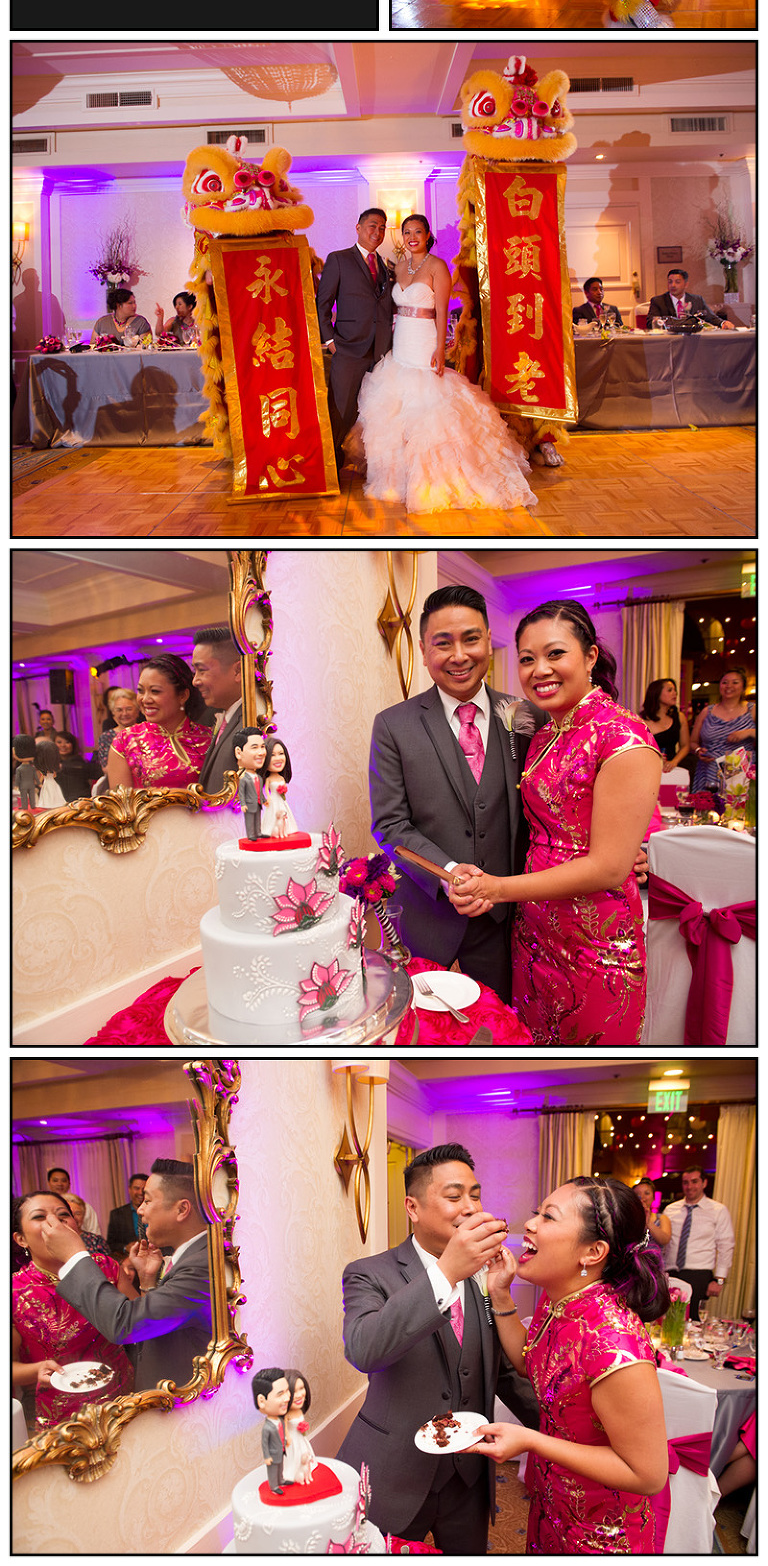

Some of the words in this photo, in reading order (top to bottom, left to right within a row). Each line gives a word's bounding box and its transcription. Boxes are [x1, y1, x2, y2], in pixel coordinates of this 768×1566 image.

[246, 255, 306, 491] 永結同心
[503, 174, 546, 403] 白頭到老
[655, 1090, 684, 1112] EXIT
